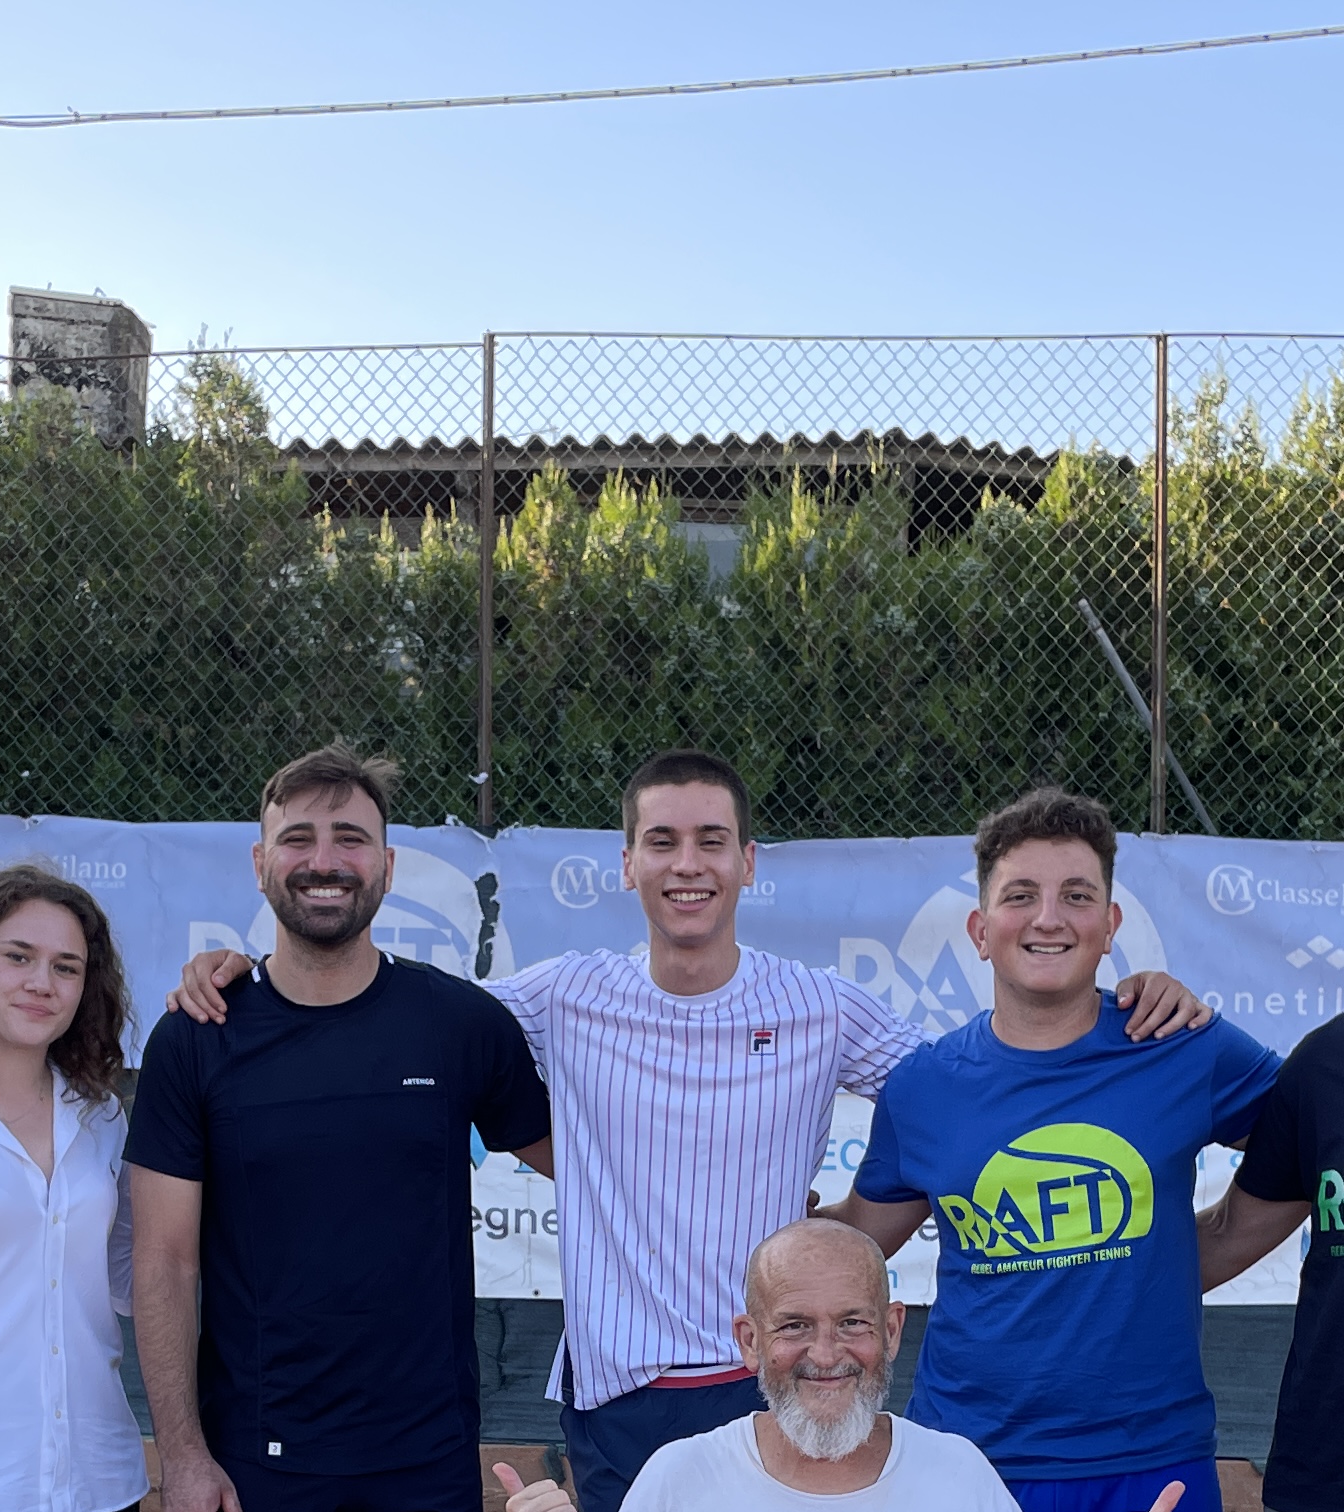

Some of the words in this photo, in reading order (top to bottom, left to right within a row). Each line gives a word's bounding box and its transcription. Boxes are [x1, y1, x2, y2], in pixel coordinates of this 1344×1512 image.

[938, 1169, 1112, 1250] RAFT
[997, 1259, 1045, 1274] AMATEUR
[1046, 1252, 1091, 1269] FIGHTER
[1093, 1245, 1132, 1263] TENNIS
